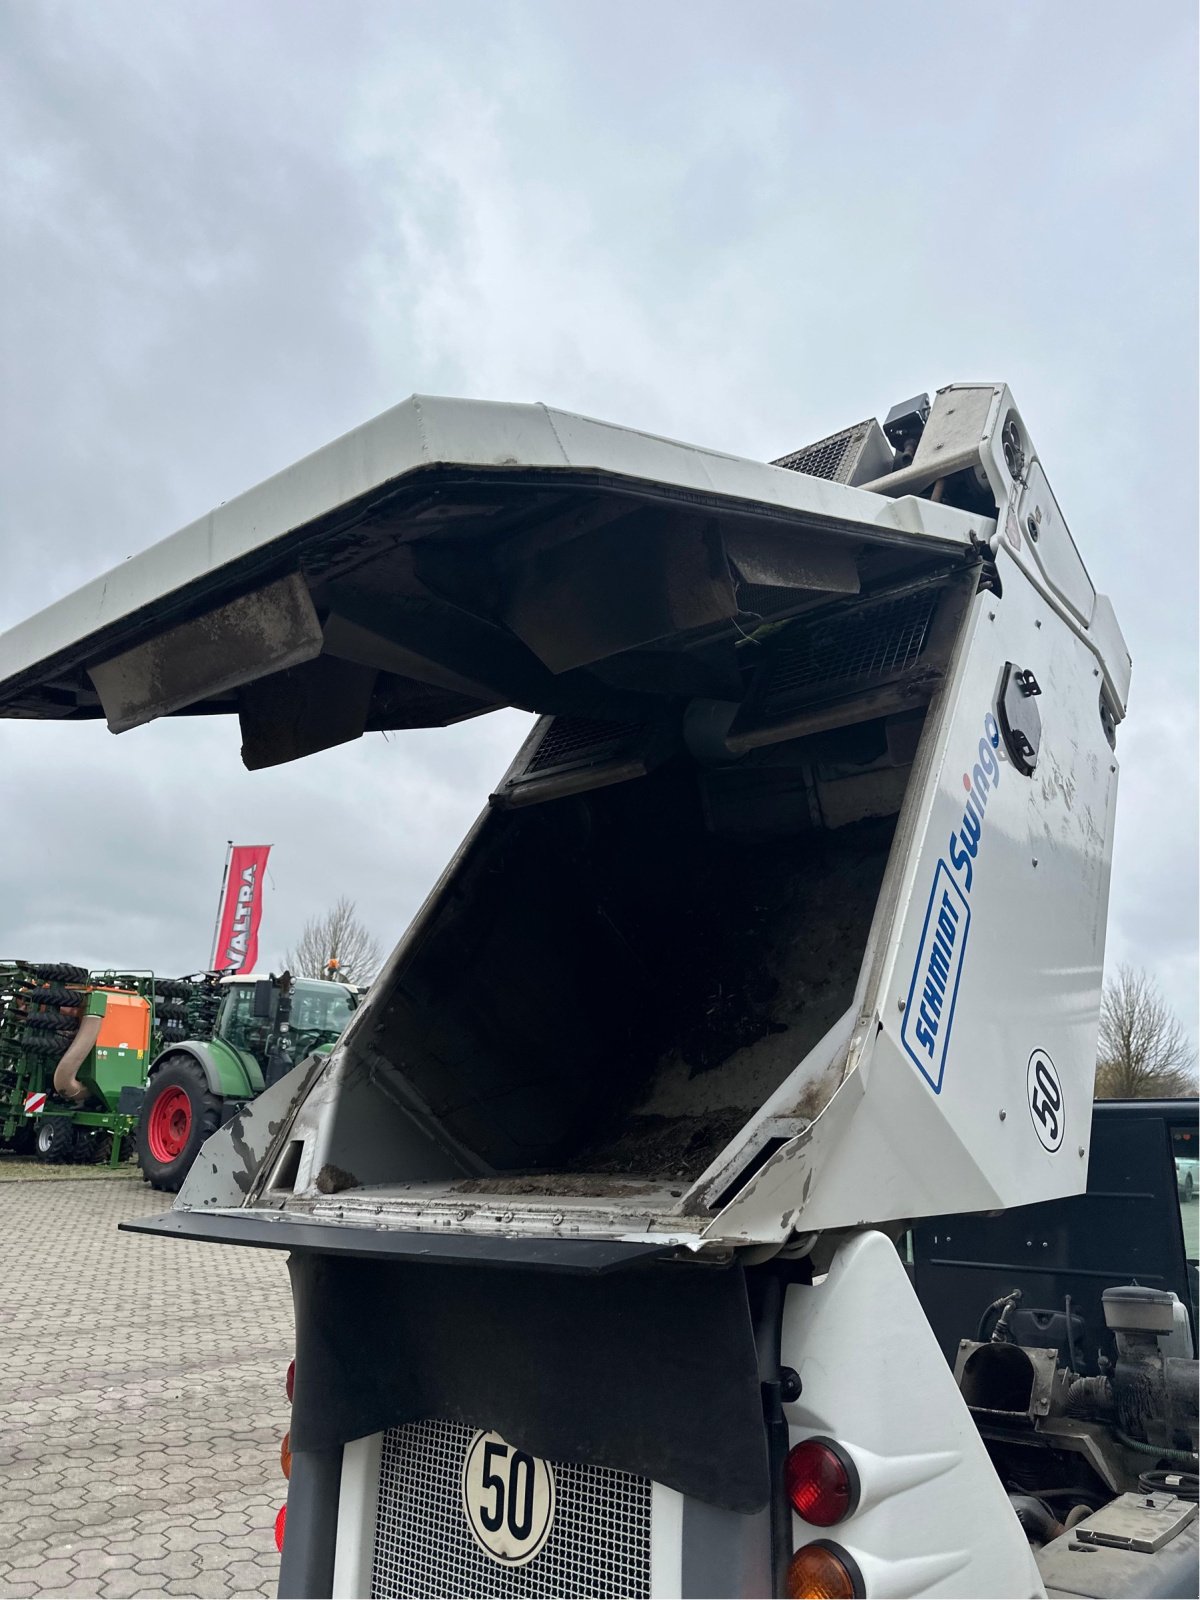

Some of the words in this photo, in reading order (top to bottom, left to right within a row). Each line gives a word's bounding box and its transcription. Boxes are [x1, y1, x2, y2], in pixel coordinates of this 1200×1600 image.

[224, 863, 257, 971] VALTRA
[915, 890, 961, 1059] SCHMIDT
[949, 712, 1000, 893] Swingo
[1032, 1061, 1061, 1140] 50
[480, 1442, 535, 1541] 50
